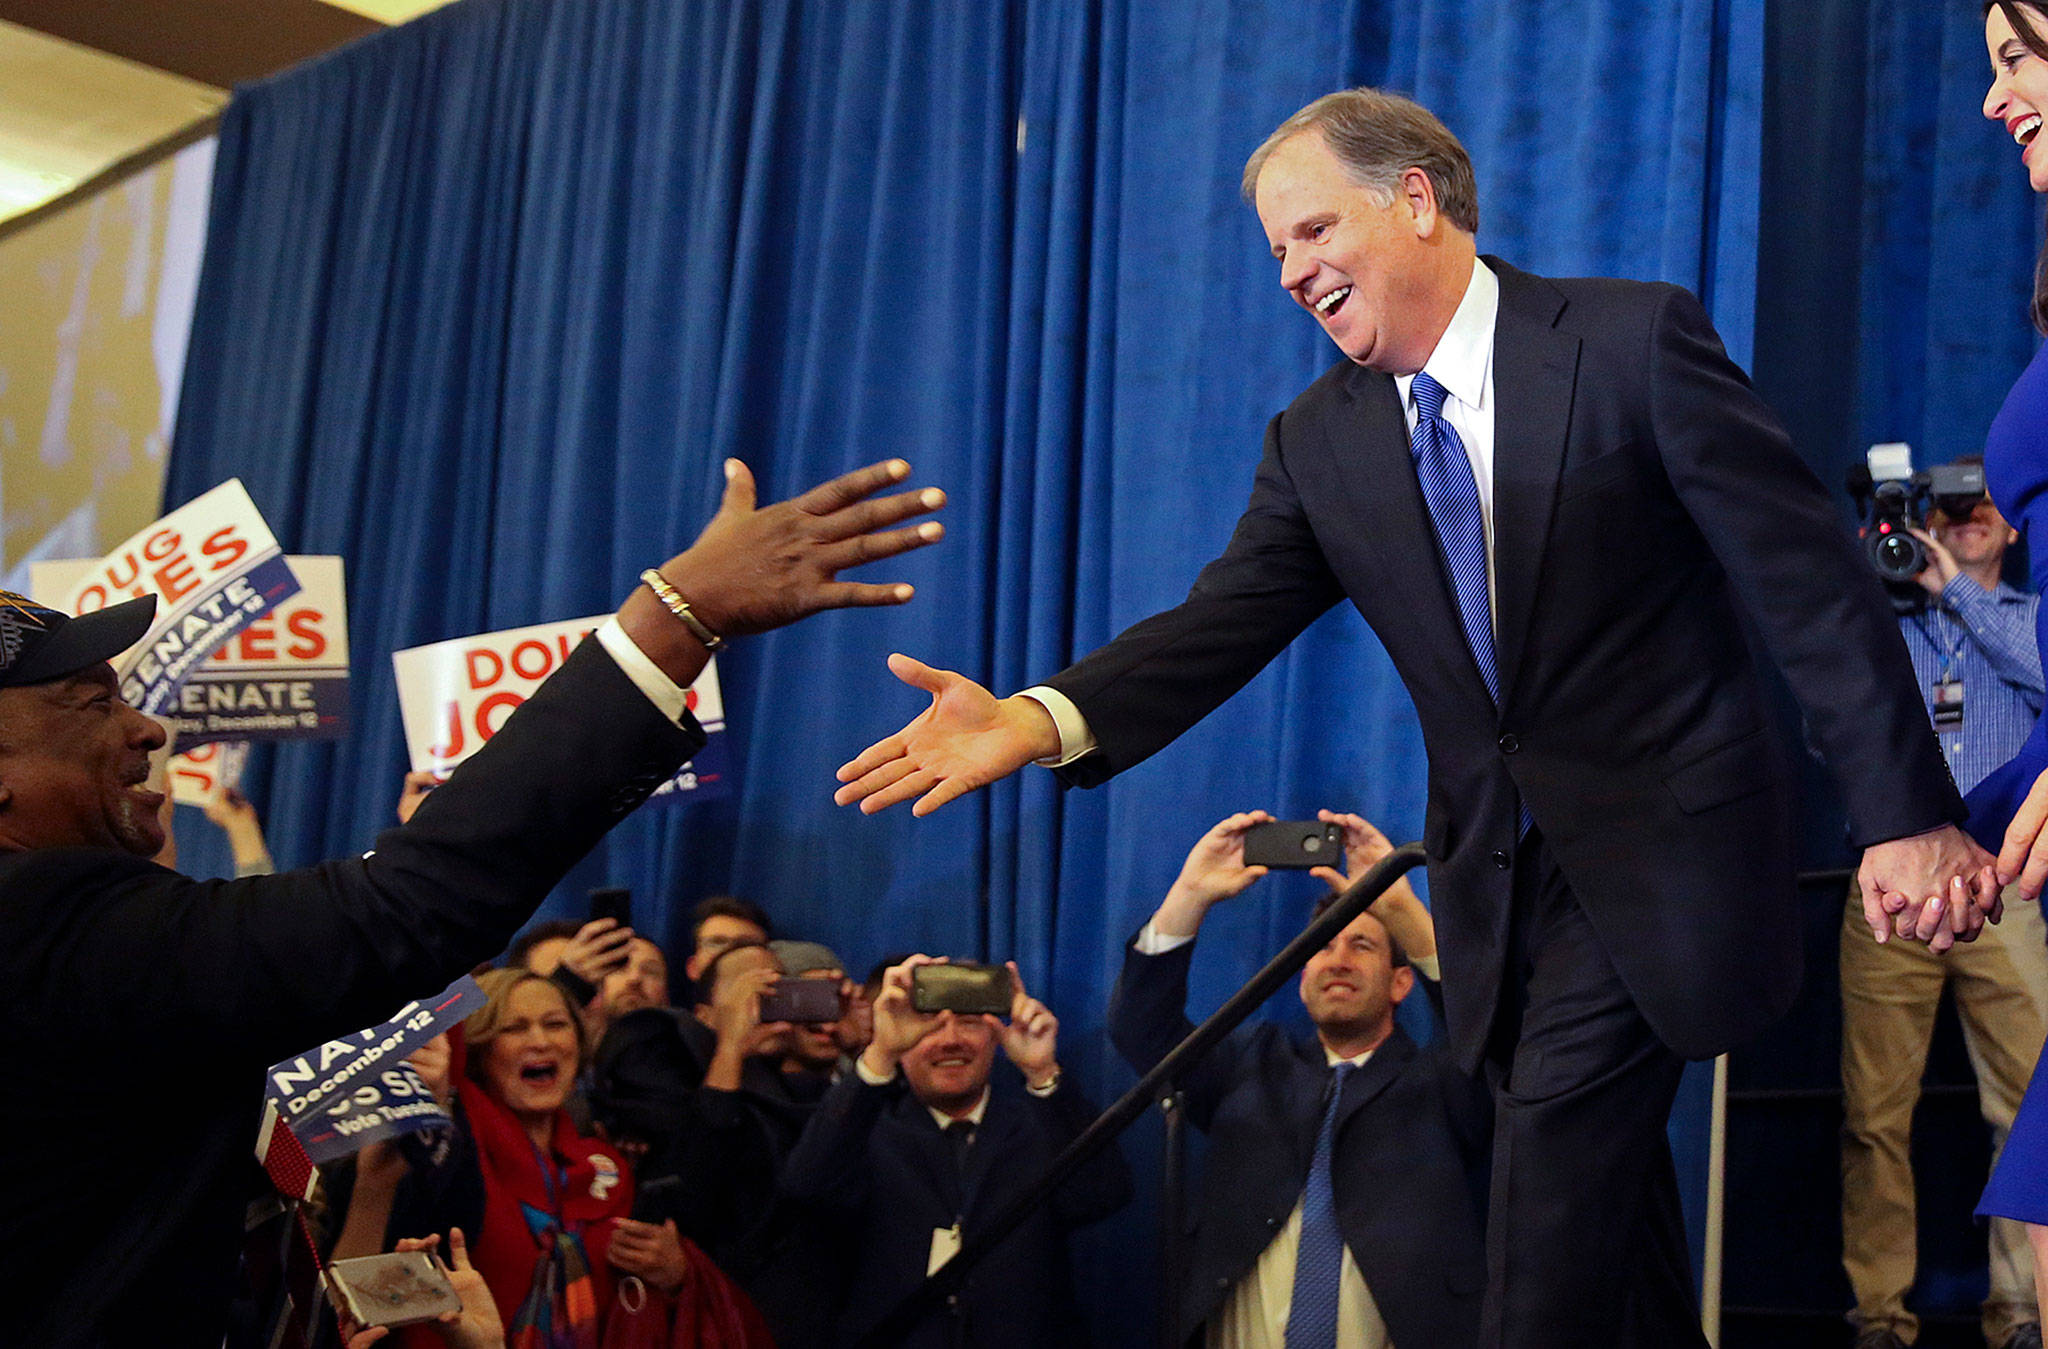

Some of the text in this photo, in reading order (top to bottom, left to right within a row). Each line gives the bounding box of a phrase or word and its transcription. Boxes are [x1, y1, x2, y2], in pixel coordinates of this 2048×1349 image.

[76, 530, 182, 617] OUG
[120, 576, 257, 708] SENATE
[211, 607, 328, 661] ES
[465, 632, 591, 690] DO
[168, 681, 317, 715] ENATE
[287, 1009, 435, 1115] December 12
[381, 1070, 433, 1098] SE
[332, 1113, 383, 1137] Vote
